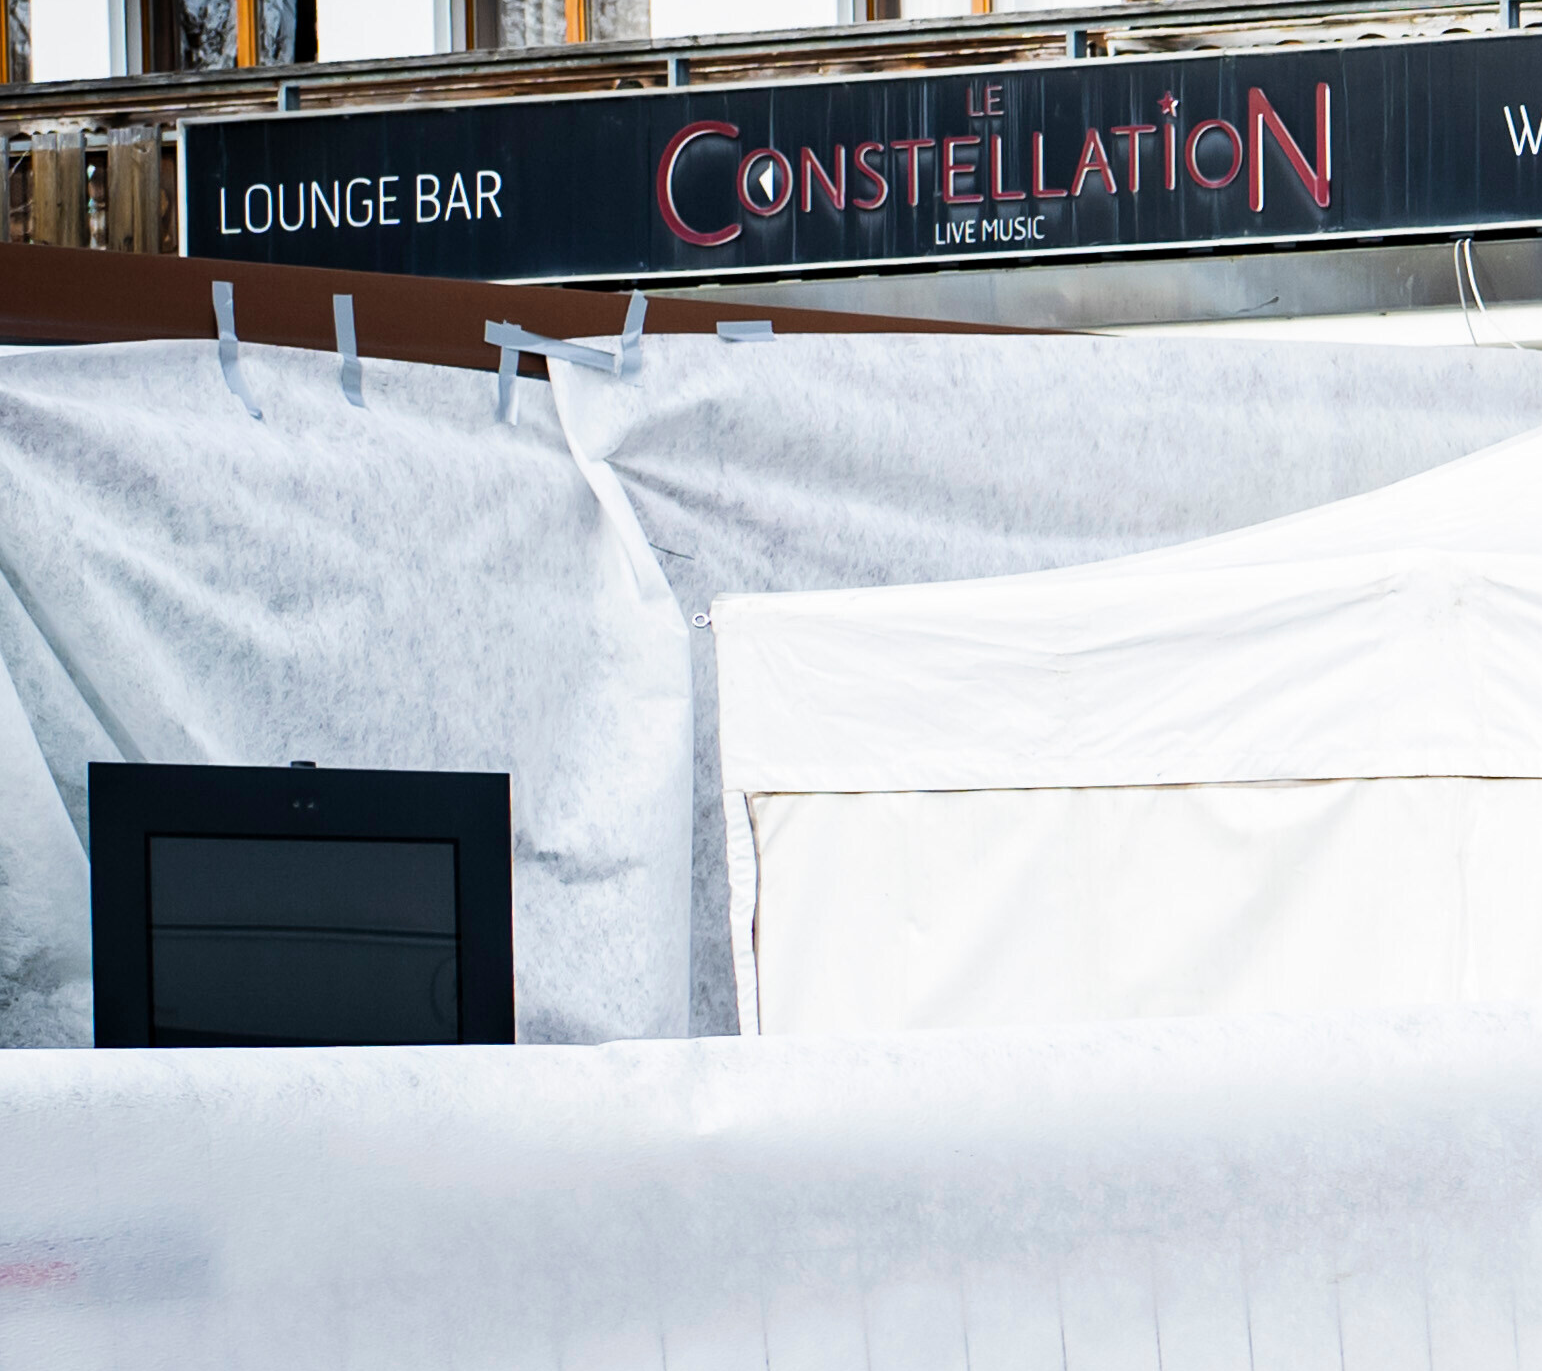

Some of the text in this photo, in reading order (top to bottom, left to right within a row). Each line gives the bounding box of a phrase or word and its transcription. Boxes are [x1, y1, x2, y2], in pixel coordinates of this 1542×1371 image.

[966, 85, 1004, 118] LE
[220, 170, 502, 234] LOUNGE BAR
[934, 215, 1046, 246] LIVE MUSIC
